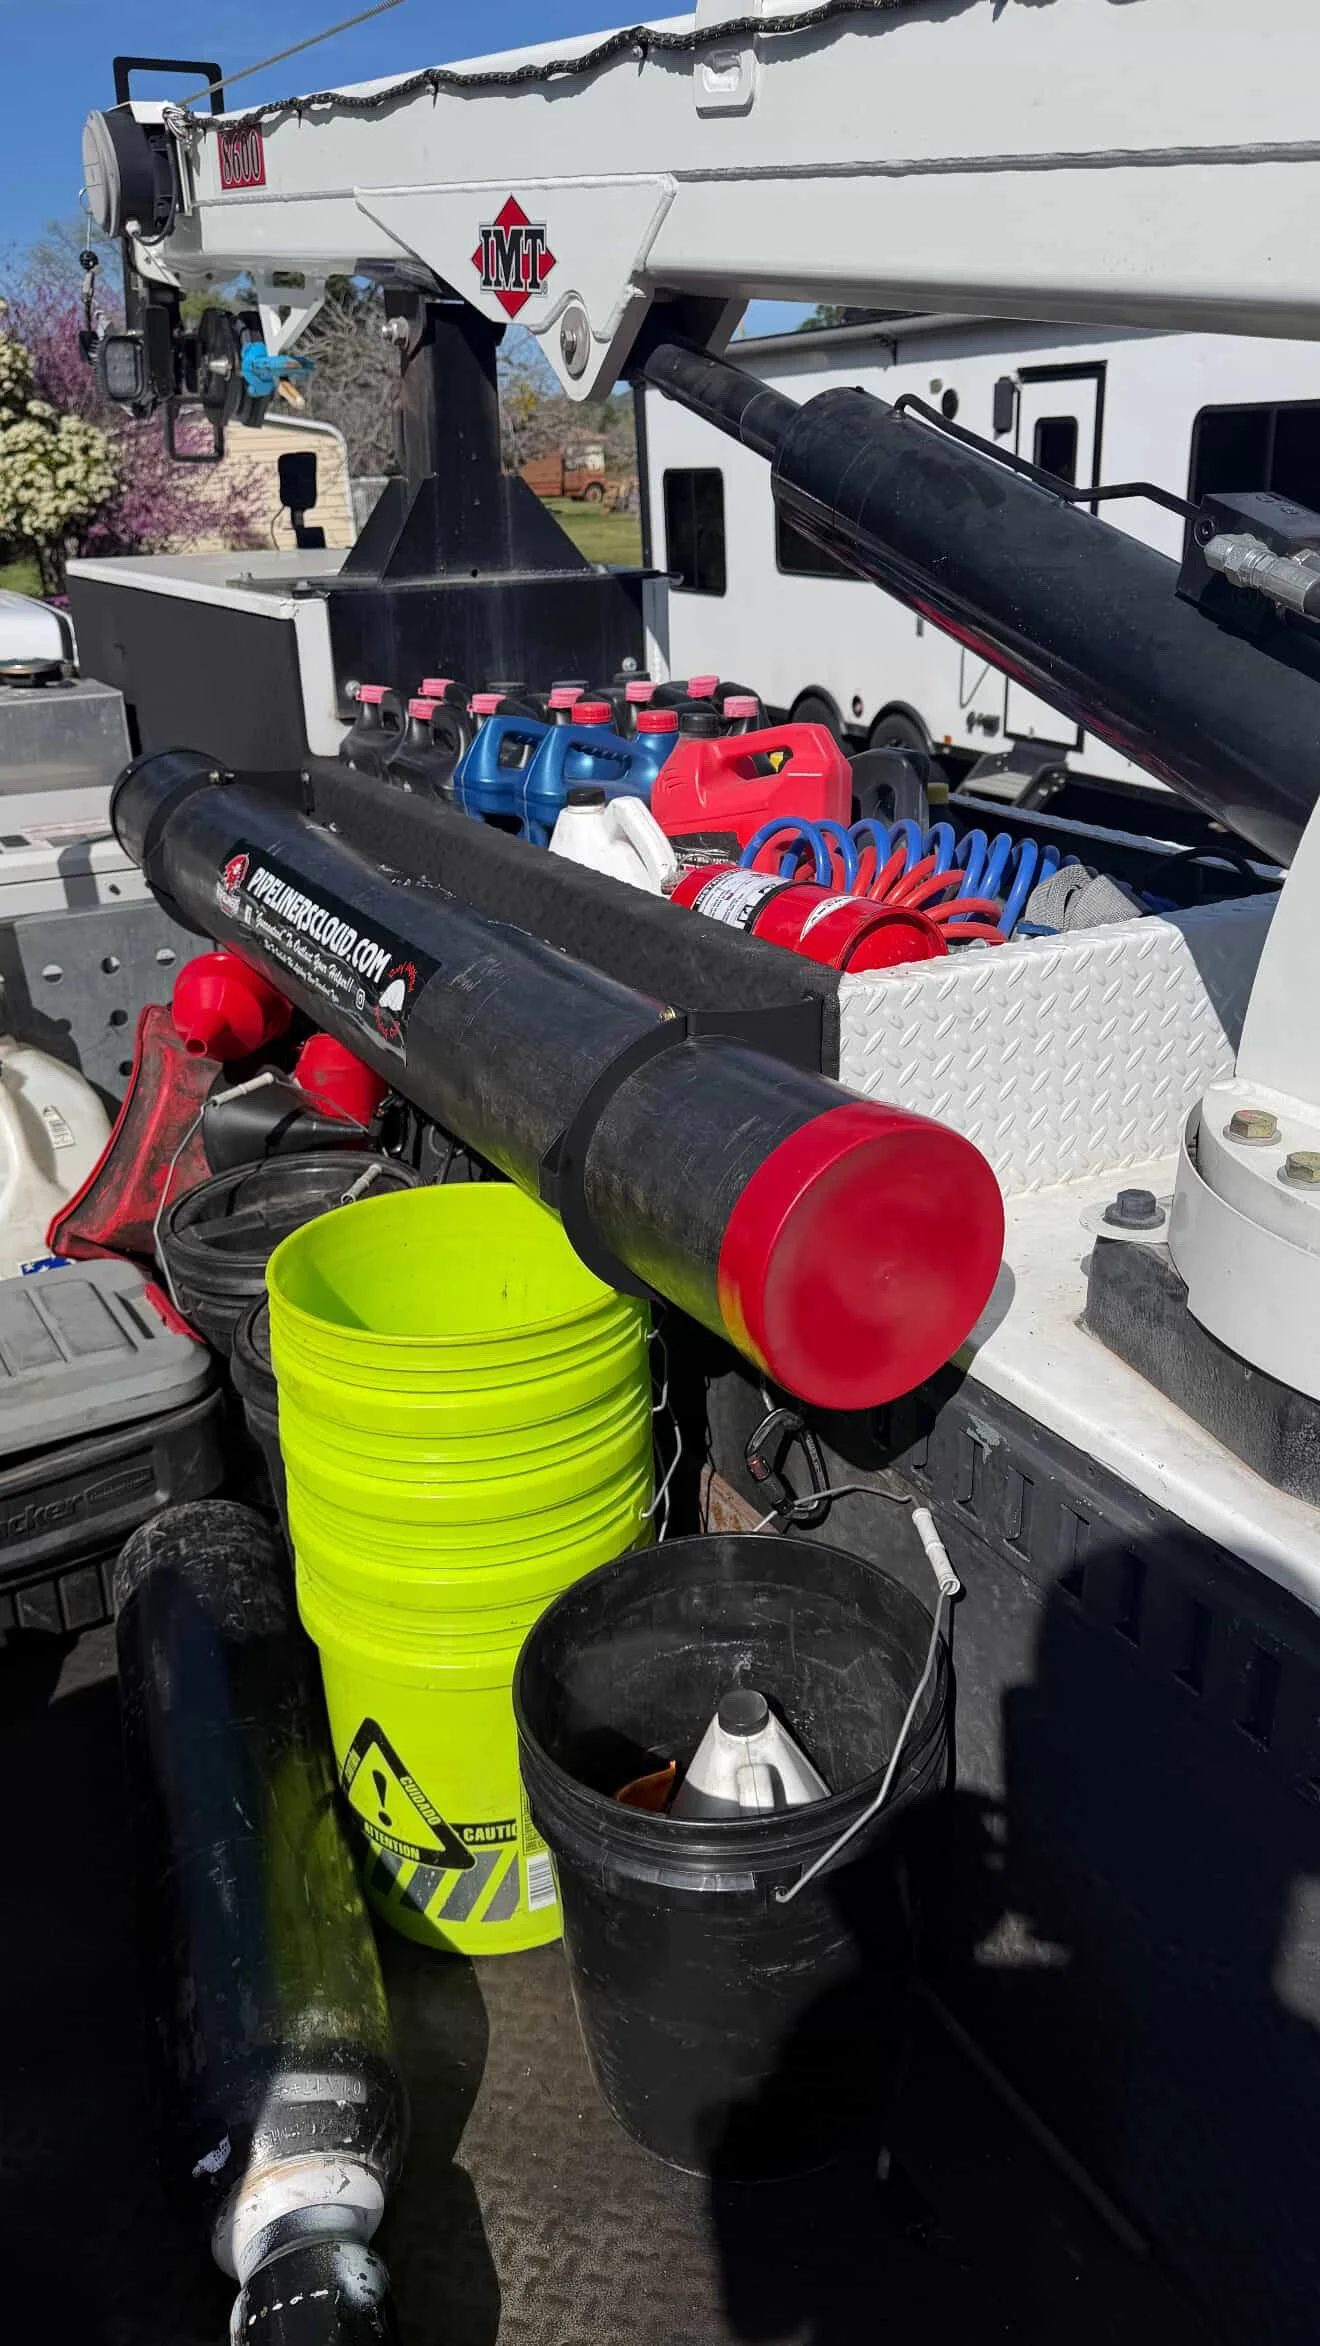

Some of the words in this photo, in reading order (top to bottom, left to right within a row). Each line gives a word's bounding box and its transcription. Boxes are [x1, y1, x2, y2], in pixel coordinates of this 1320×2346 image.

[222, 129, 262, 185] 8600
[480, 225, 547, 293] IMT
[247, 866, 393, 984] PIPELINERSCLOUD.COM
[400, 1776, 442, 1826] CUIDADO
[364, 1821, 420, 1861] ATTENTION
